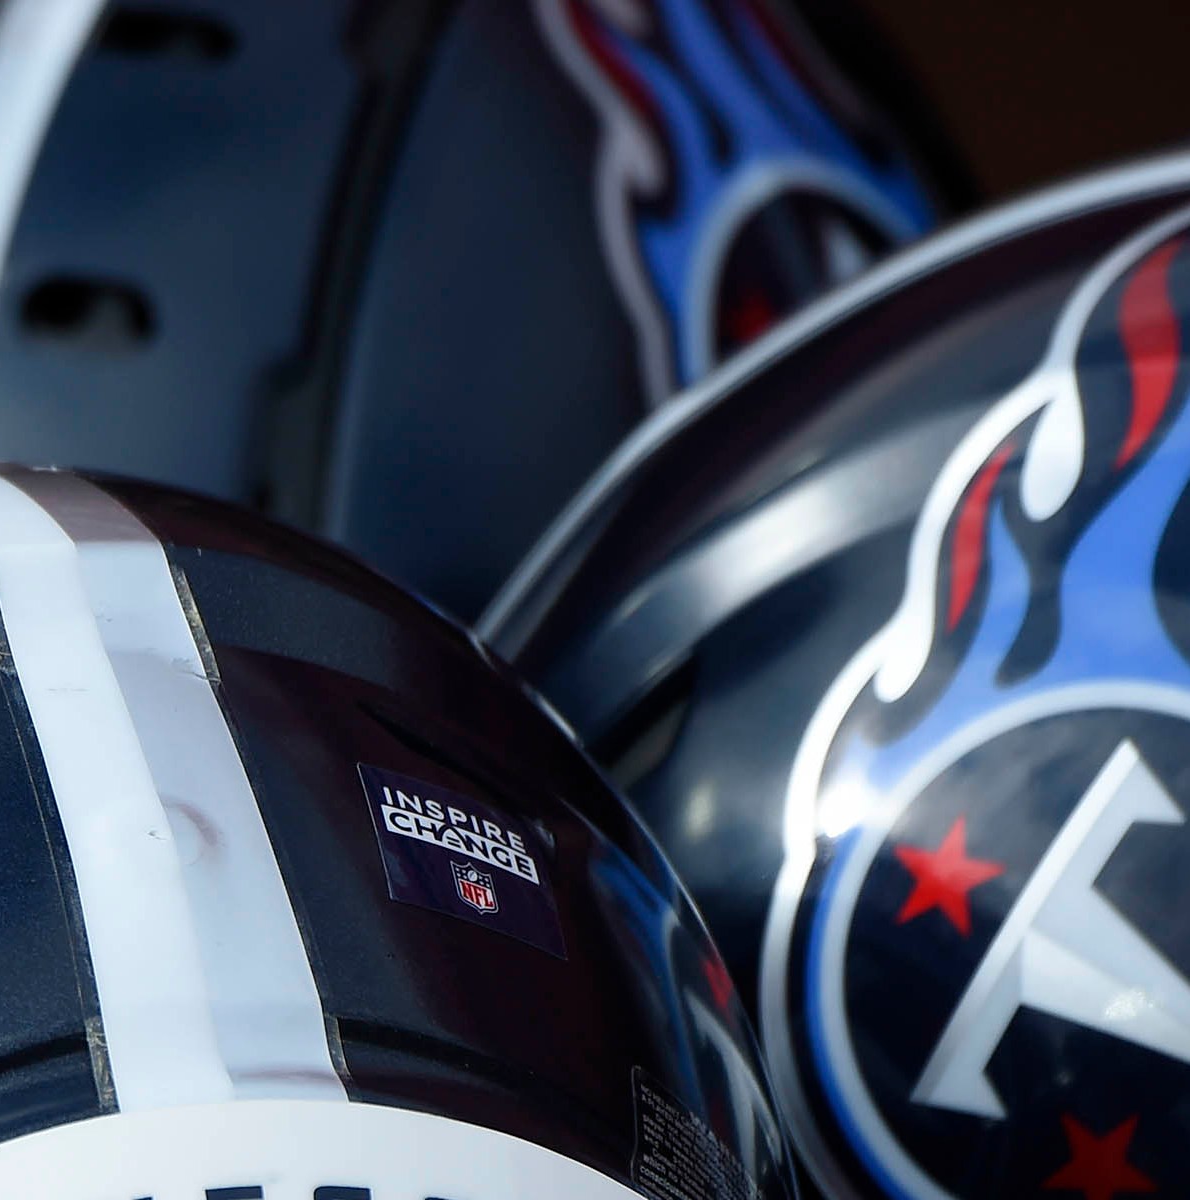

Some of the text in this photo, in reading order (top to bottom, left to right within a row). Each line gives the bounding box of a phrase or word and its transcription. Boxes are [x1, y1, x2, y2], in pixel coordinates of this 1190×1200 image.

[382, 786, 527, 854] INSPIRE
[388, 812, 534, 879] CHANGE
[460, 880, 494, 908] NFL
